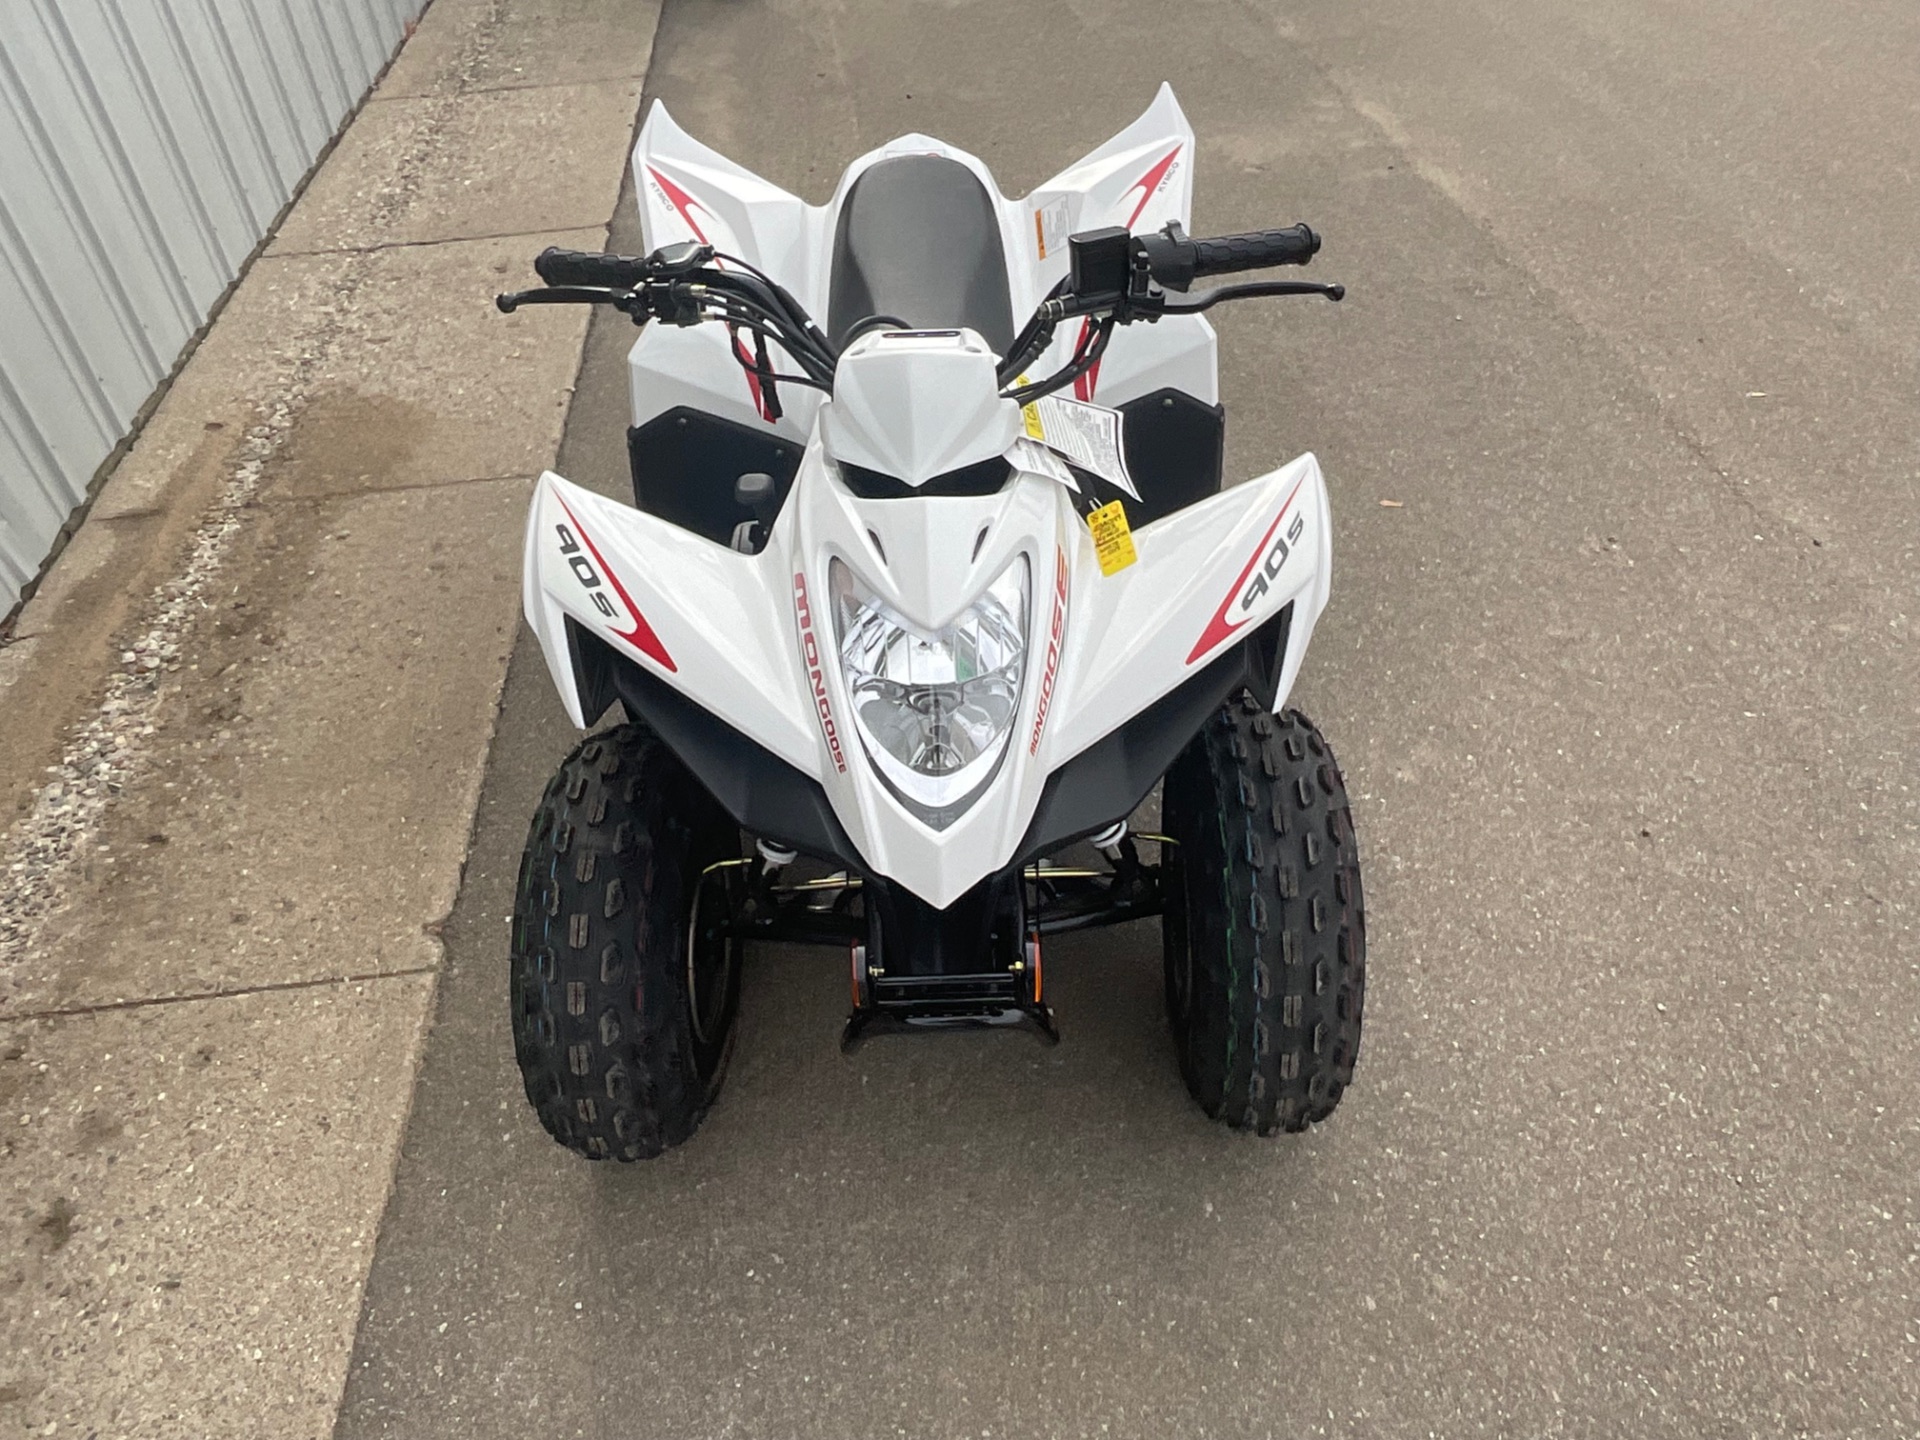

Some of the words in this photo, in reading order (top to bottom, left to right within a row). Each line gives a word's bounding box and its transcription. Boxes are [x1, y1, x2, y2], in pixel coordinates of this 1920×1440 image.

[1158, 162, 1179, 192] KYMCO
[793, 572, 847, 774] MONGOOSE
[1030, 544, 1068, 757] MONGOOSE
